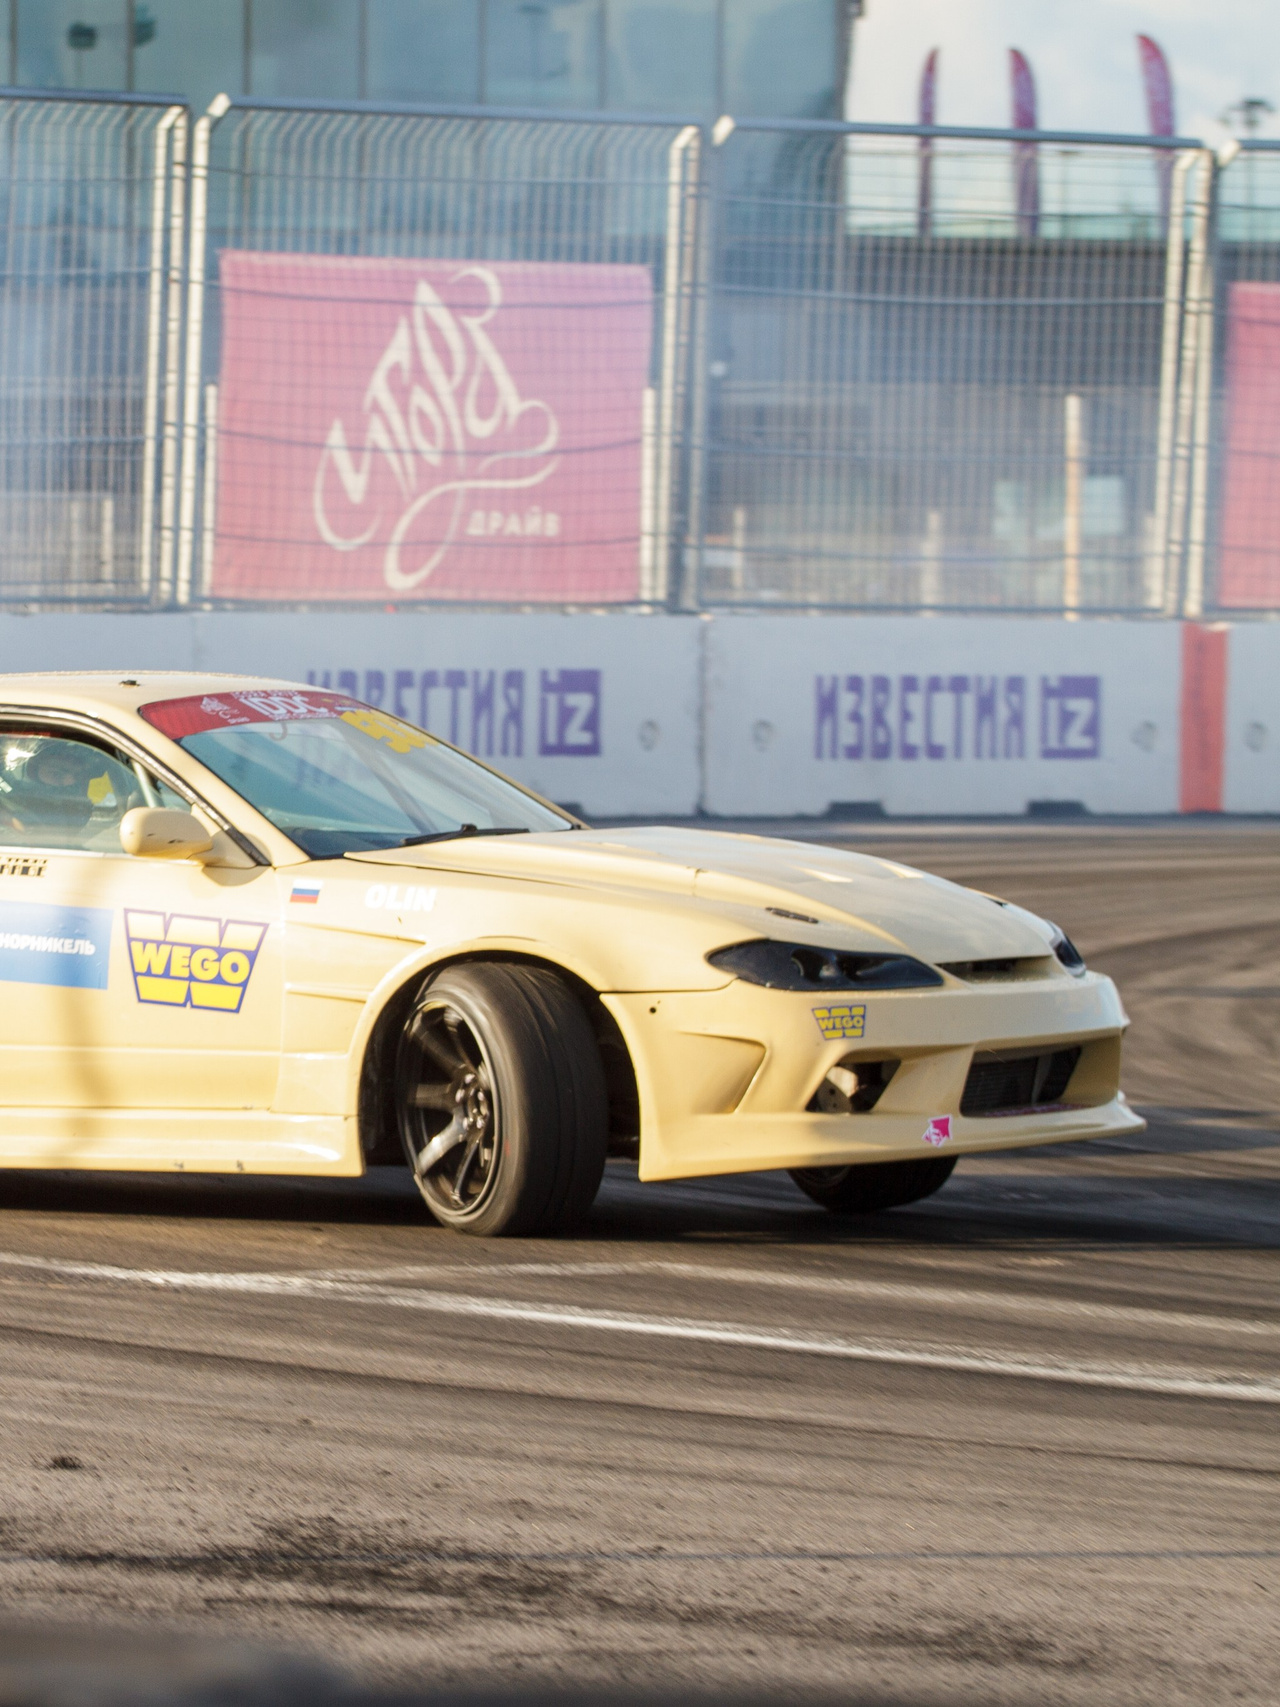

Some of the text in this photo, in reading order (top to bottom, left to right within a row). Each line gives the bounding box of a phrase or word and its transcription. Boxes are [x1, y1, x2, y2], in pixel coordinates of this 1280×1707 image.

[466, 506, 561, 537] ДРАЙВ
[815, 674, 1026, 760] ИЗВЕСТИЯ
[364, 884, 437, 912] OLIN
[129, 940, 251, 985] WEGO
[818, 1016, 864, 1031] WEGO
